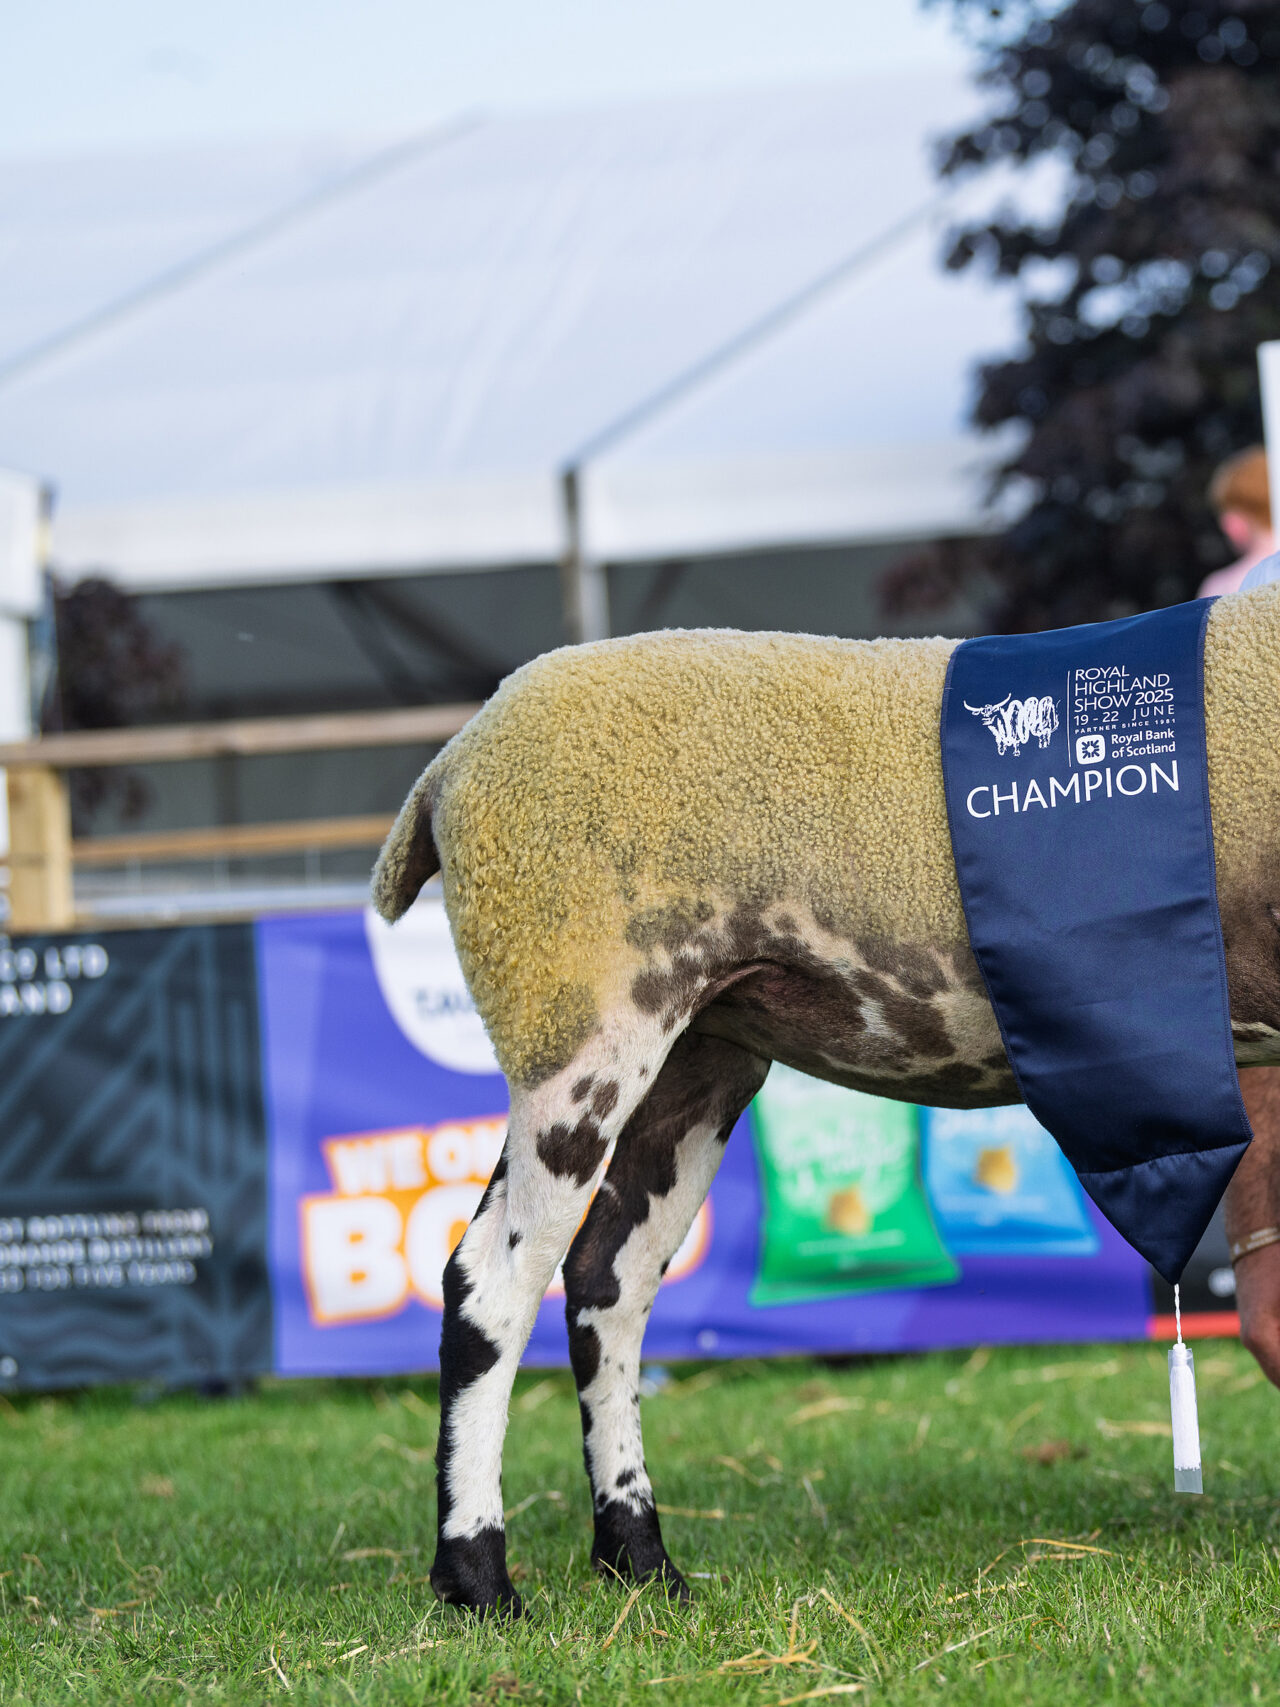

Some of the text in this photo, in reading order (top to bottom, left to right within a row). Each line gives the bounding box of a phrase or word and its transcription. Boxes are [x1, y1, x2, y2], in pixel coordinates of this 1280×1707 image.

[1075, 665, 1130, 681] ROYAL
[1075, 674, 1170, 696] HIGHLAND
[1074, 688, 1174, 712] SHOW 2025
[1073, 714, 1089, 726] 19
[1102, 710, 1119, 723] 22
[1131, 704, 1175, 721] JUNE
[1074, 724, 1117, 735] PARTNER
[1121, 720, 1150, 729] SINCE
[1111, 728, 1175, 746] Royal Bank
[1111, 741, 1176, 758] of Scotland
[965, 759, 1180, 819] CHAMPION
[44, 944, 108, 979] LTD
[331, 1133, 428, 1196] WE
